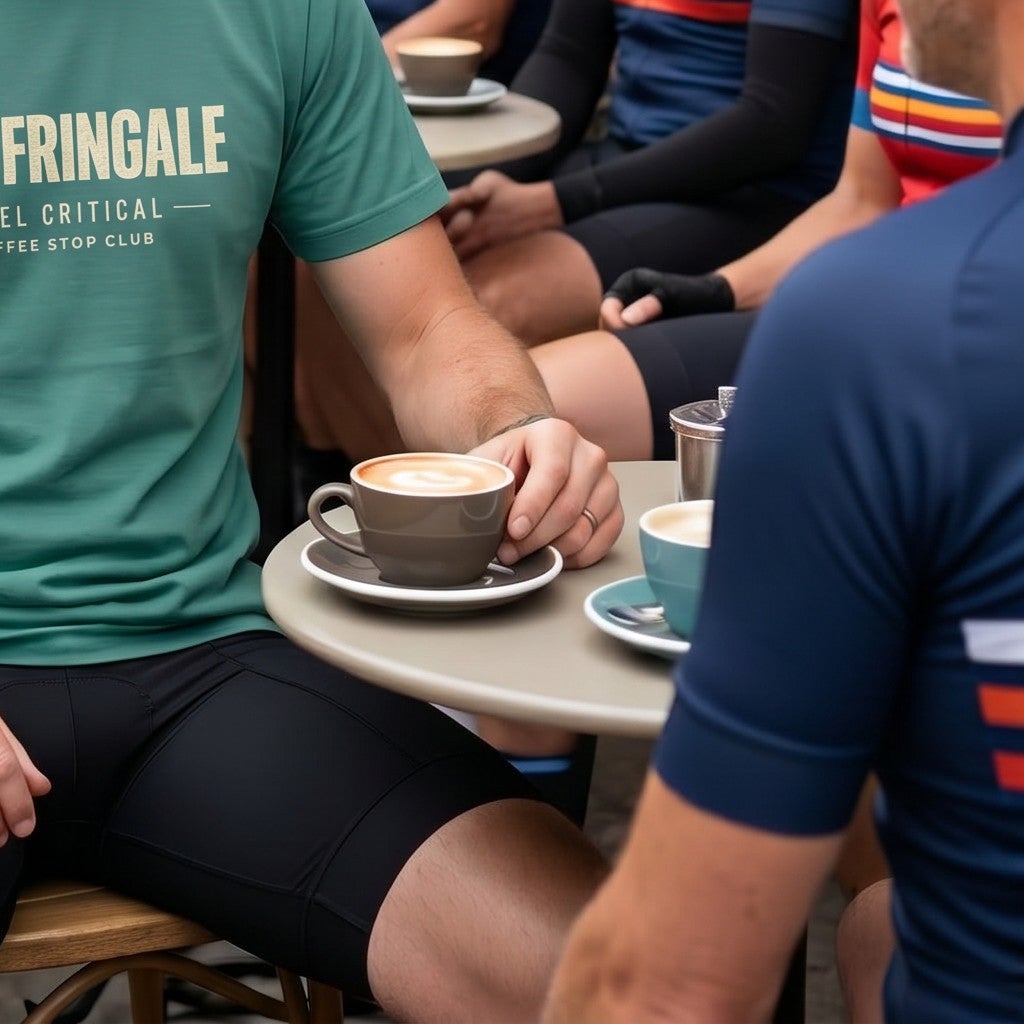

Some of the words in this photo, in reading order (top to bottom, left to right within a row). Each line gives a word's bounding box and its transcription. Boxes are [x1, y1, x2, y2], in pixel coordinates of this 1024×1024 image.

[1, 105, 228, 185] FRINGALE
[42, 198, 163, 225] CRITICAL
[48, 236, 96, 251] STOP
[105, 232, 155, 247] CLUB
